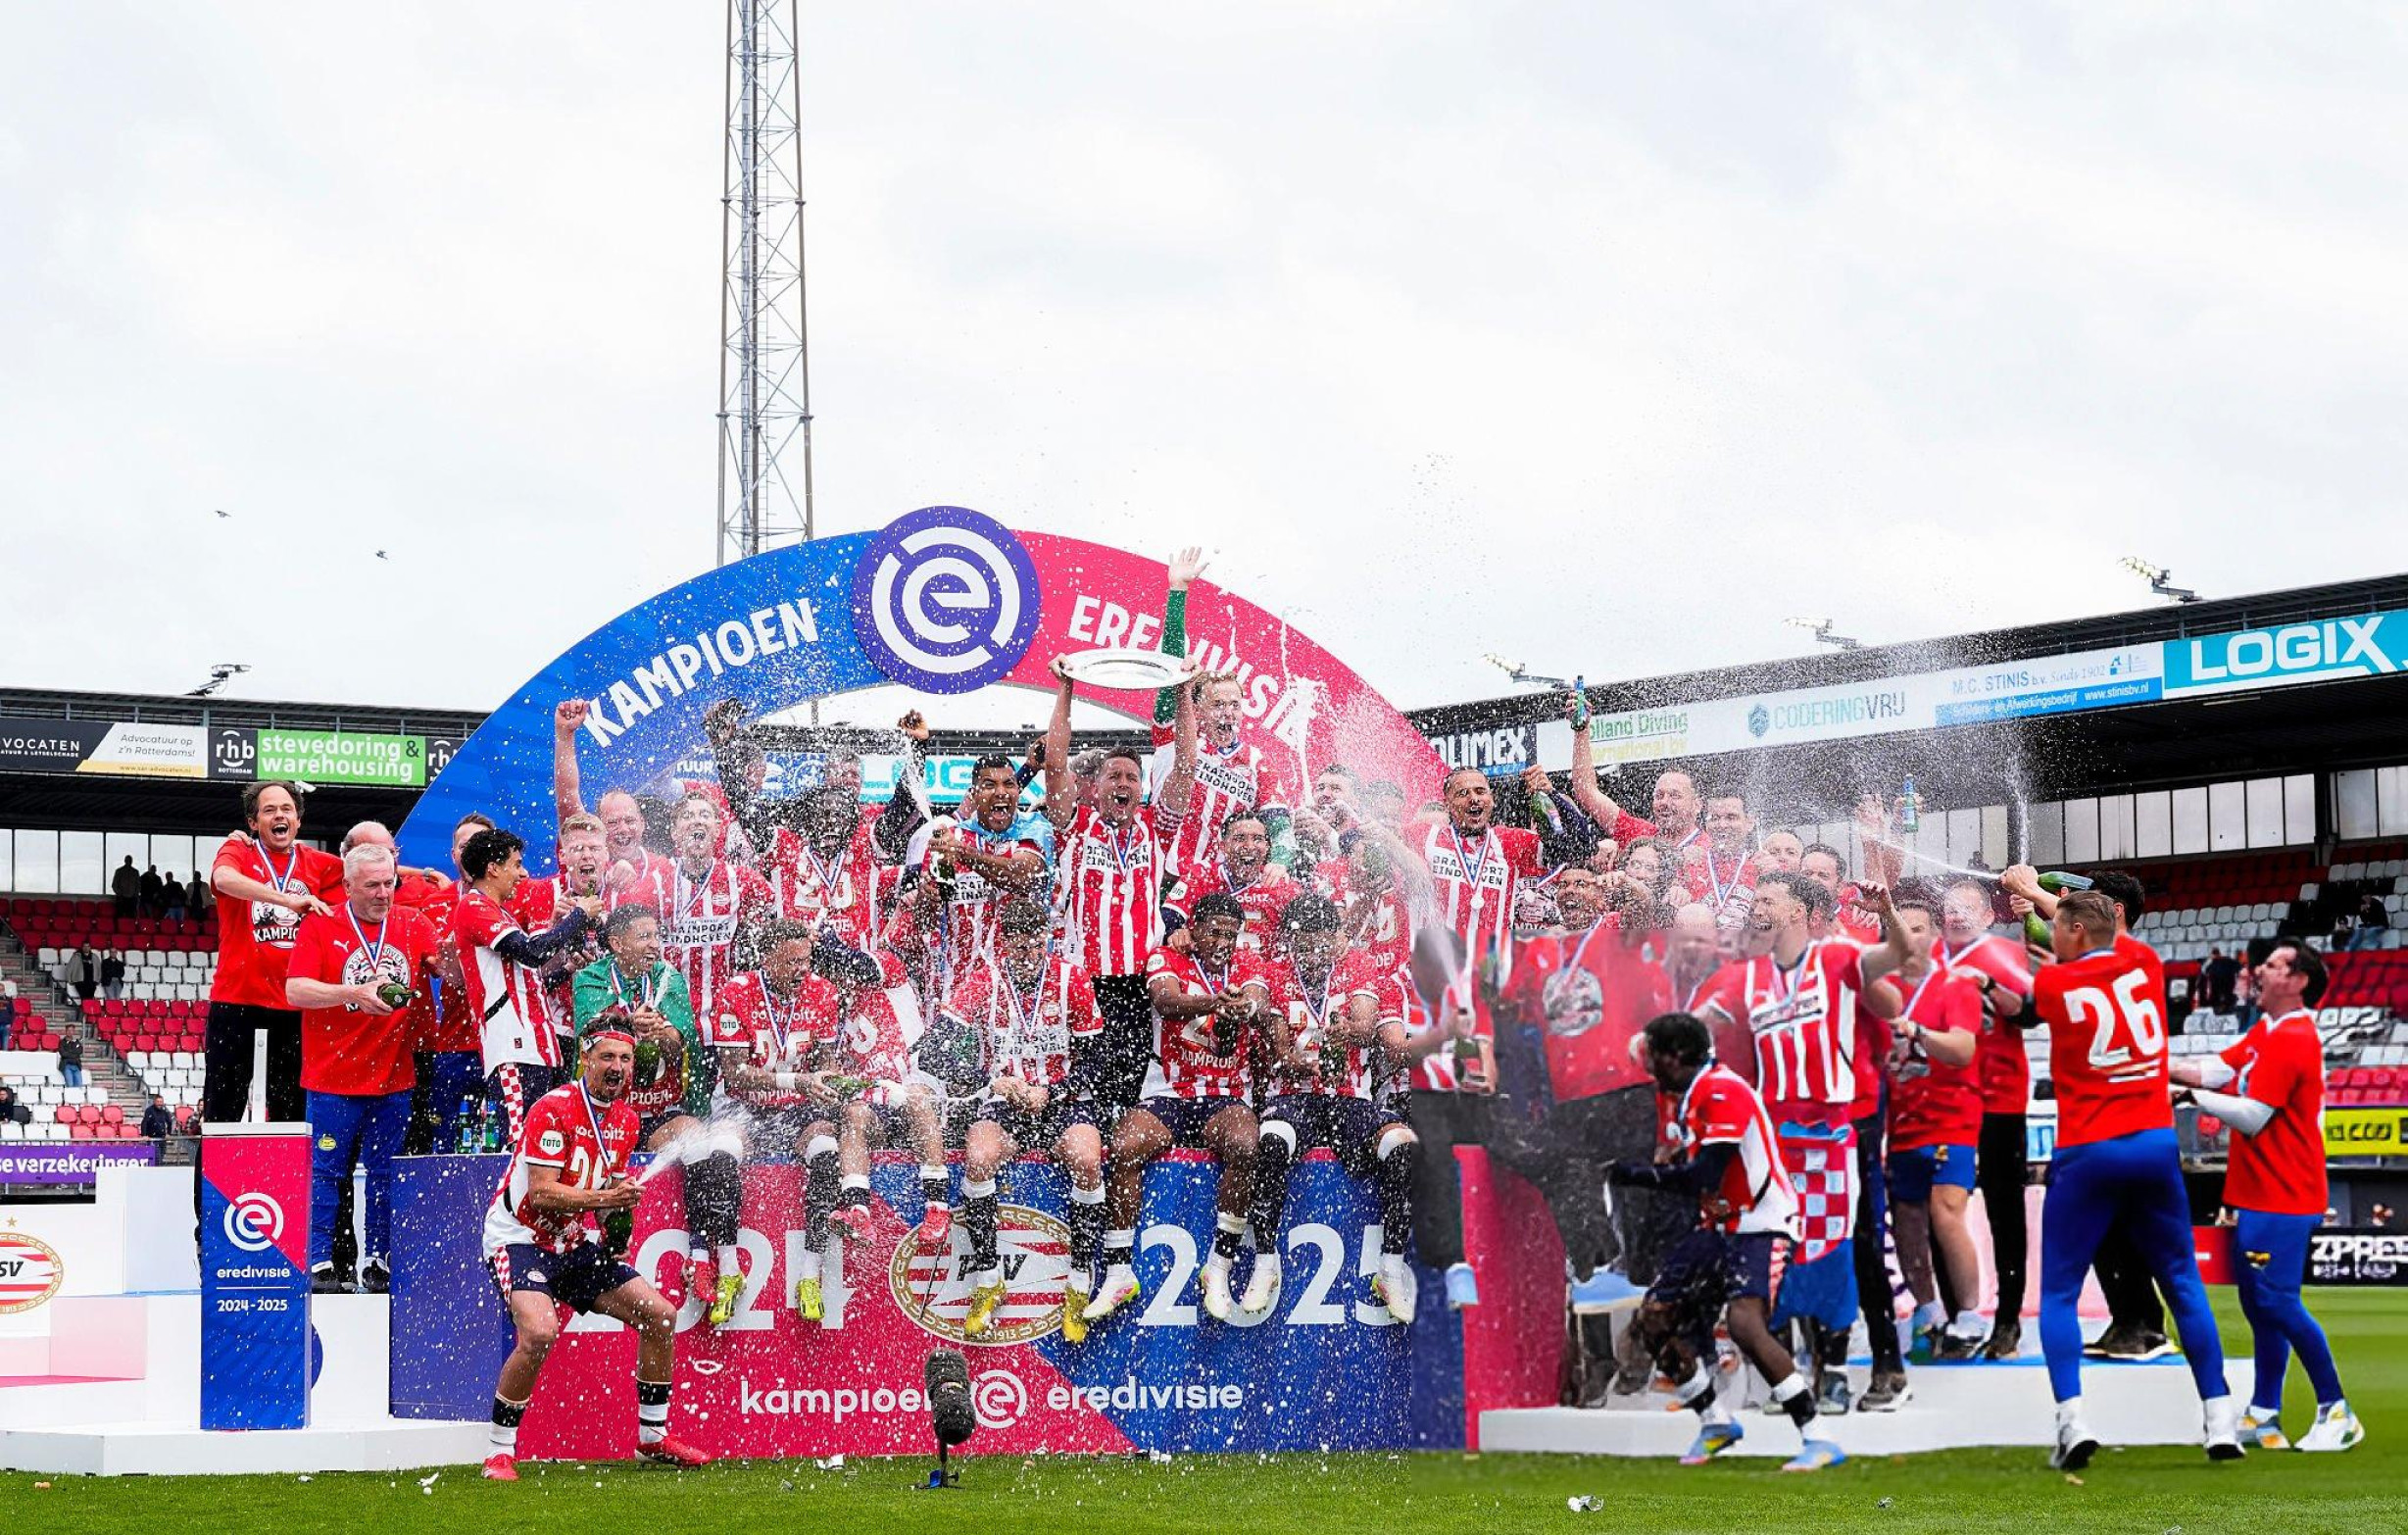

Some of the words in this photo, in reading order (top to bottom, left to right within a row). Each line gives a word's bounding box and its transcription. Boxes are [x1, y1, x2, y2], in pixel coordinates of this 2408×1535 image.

[2190, 616, 2398, 680] LOGIX
[583, 599, 819, 748] KAMPIOEN
[1986, 670, 2030, 691] STINIS
[2085, 681, 2149, 702] www.stinisbv.nl
[1638, 711, 1689, 735] Diving
[2, 738, 80, 752] VOCATEN
[121, 734, 178, 745] Advocatuur
[135, 746, 196, 758] Rotterdams!
[216, 740, 255, 760] rhb
[262, 735, 401, 762] stevedoring
[406, 740, 419, 758] &
[428, 740, 458, 767] rh
[262, 754, 413, 782] warehousing
[2064, 968, 2163, 1066] 26
[542, 1138, 561, 1148] TOTO
[217, 1267, 291, 1280] eredivisie
[958, 1254, 1028, 1281] PV
[563, 1228, 859, 1334] 024
[1048, 1376, 1244, 1411] eredivisie
